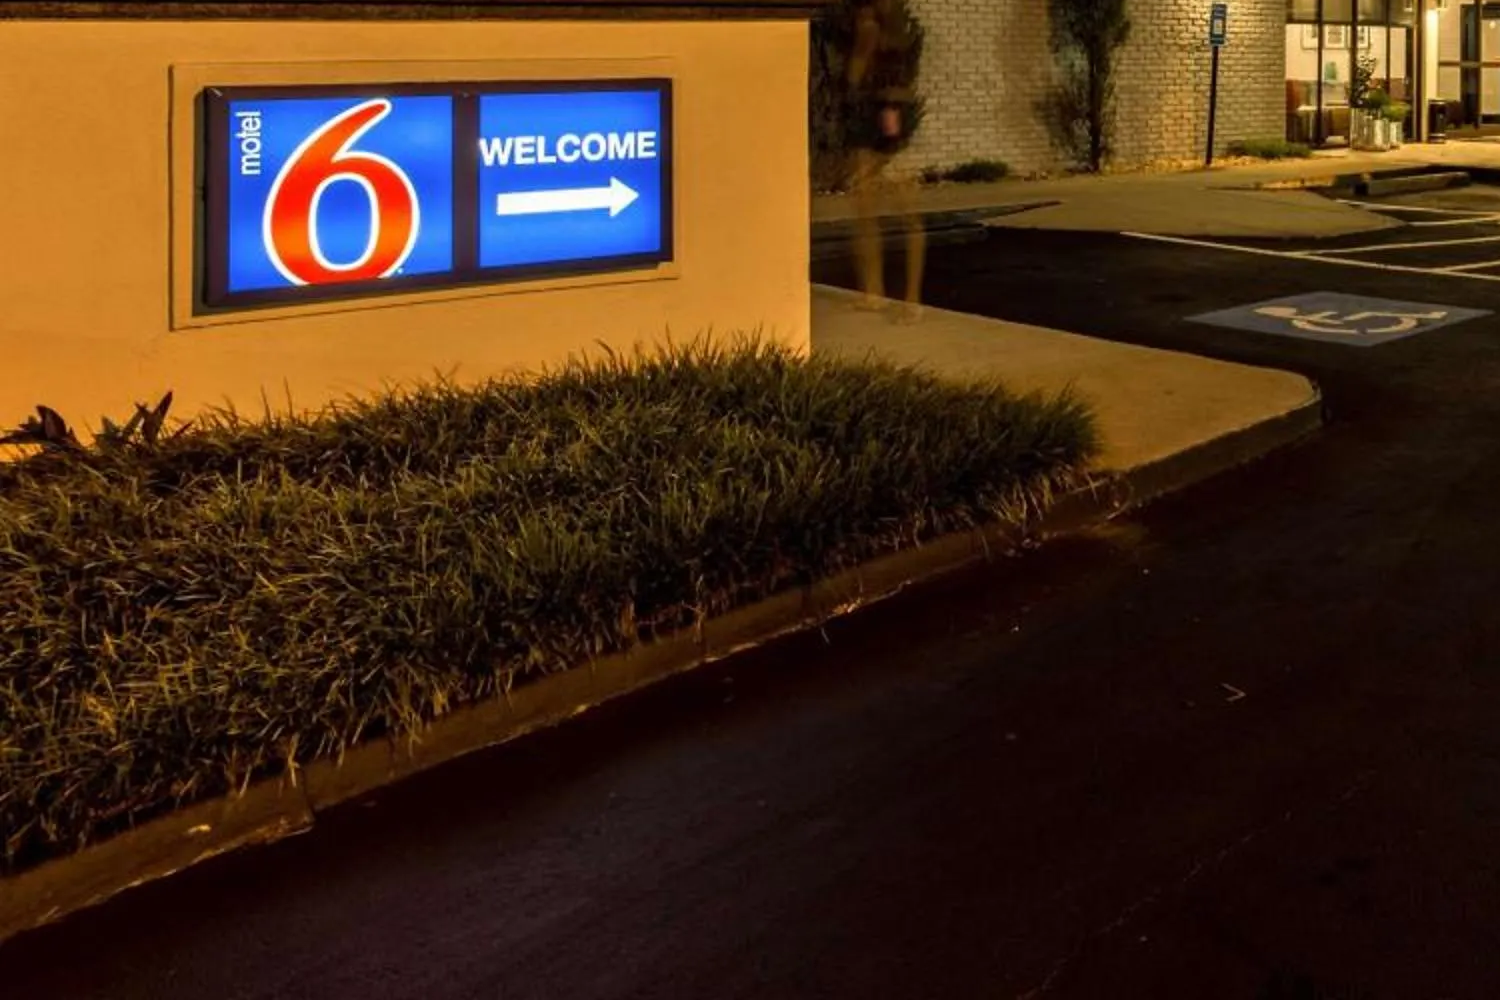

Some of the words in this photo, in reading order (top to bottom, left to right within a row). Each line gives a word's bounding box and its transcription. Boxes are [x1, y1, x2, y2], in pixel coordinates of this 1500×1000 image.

[235, 111, 261, 175] motel
[479, 131, 657, 167] WELCOME
[263, 98, 420, 286] 6
